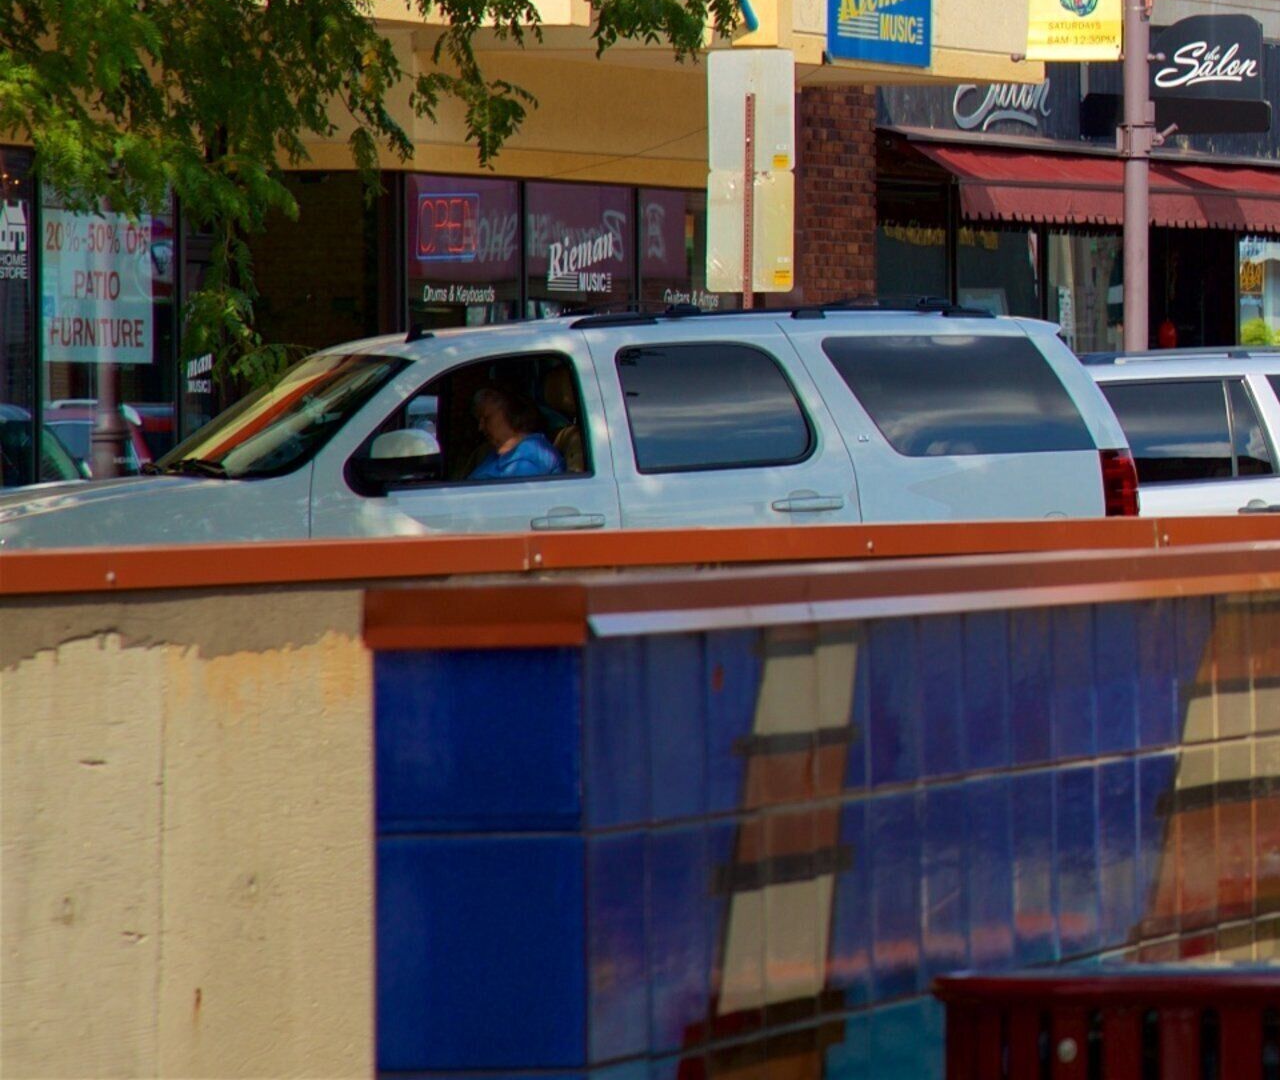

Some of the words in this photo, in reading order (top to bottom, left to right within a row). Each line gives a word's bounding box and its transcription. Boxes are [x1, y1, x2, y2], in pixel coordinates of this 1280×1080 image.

[880, 13, 917, 44] MUSIC
[1048, 22, 1102, 30] SATURDAYS
[1155, 41, 1257, 88] Salon
[1204, 46, 1219, 60] the
[550, 231, 613, 280] Rieman
[74, 270, 121, 300] PATIO
[578, 272, 607, 292] MUSIC
[50, 317, 144, 348] FURNITURE
